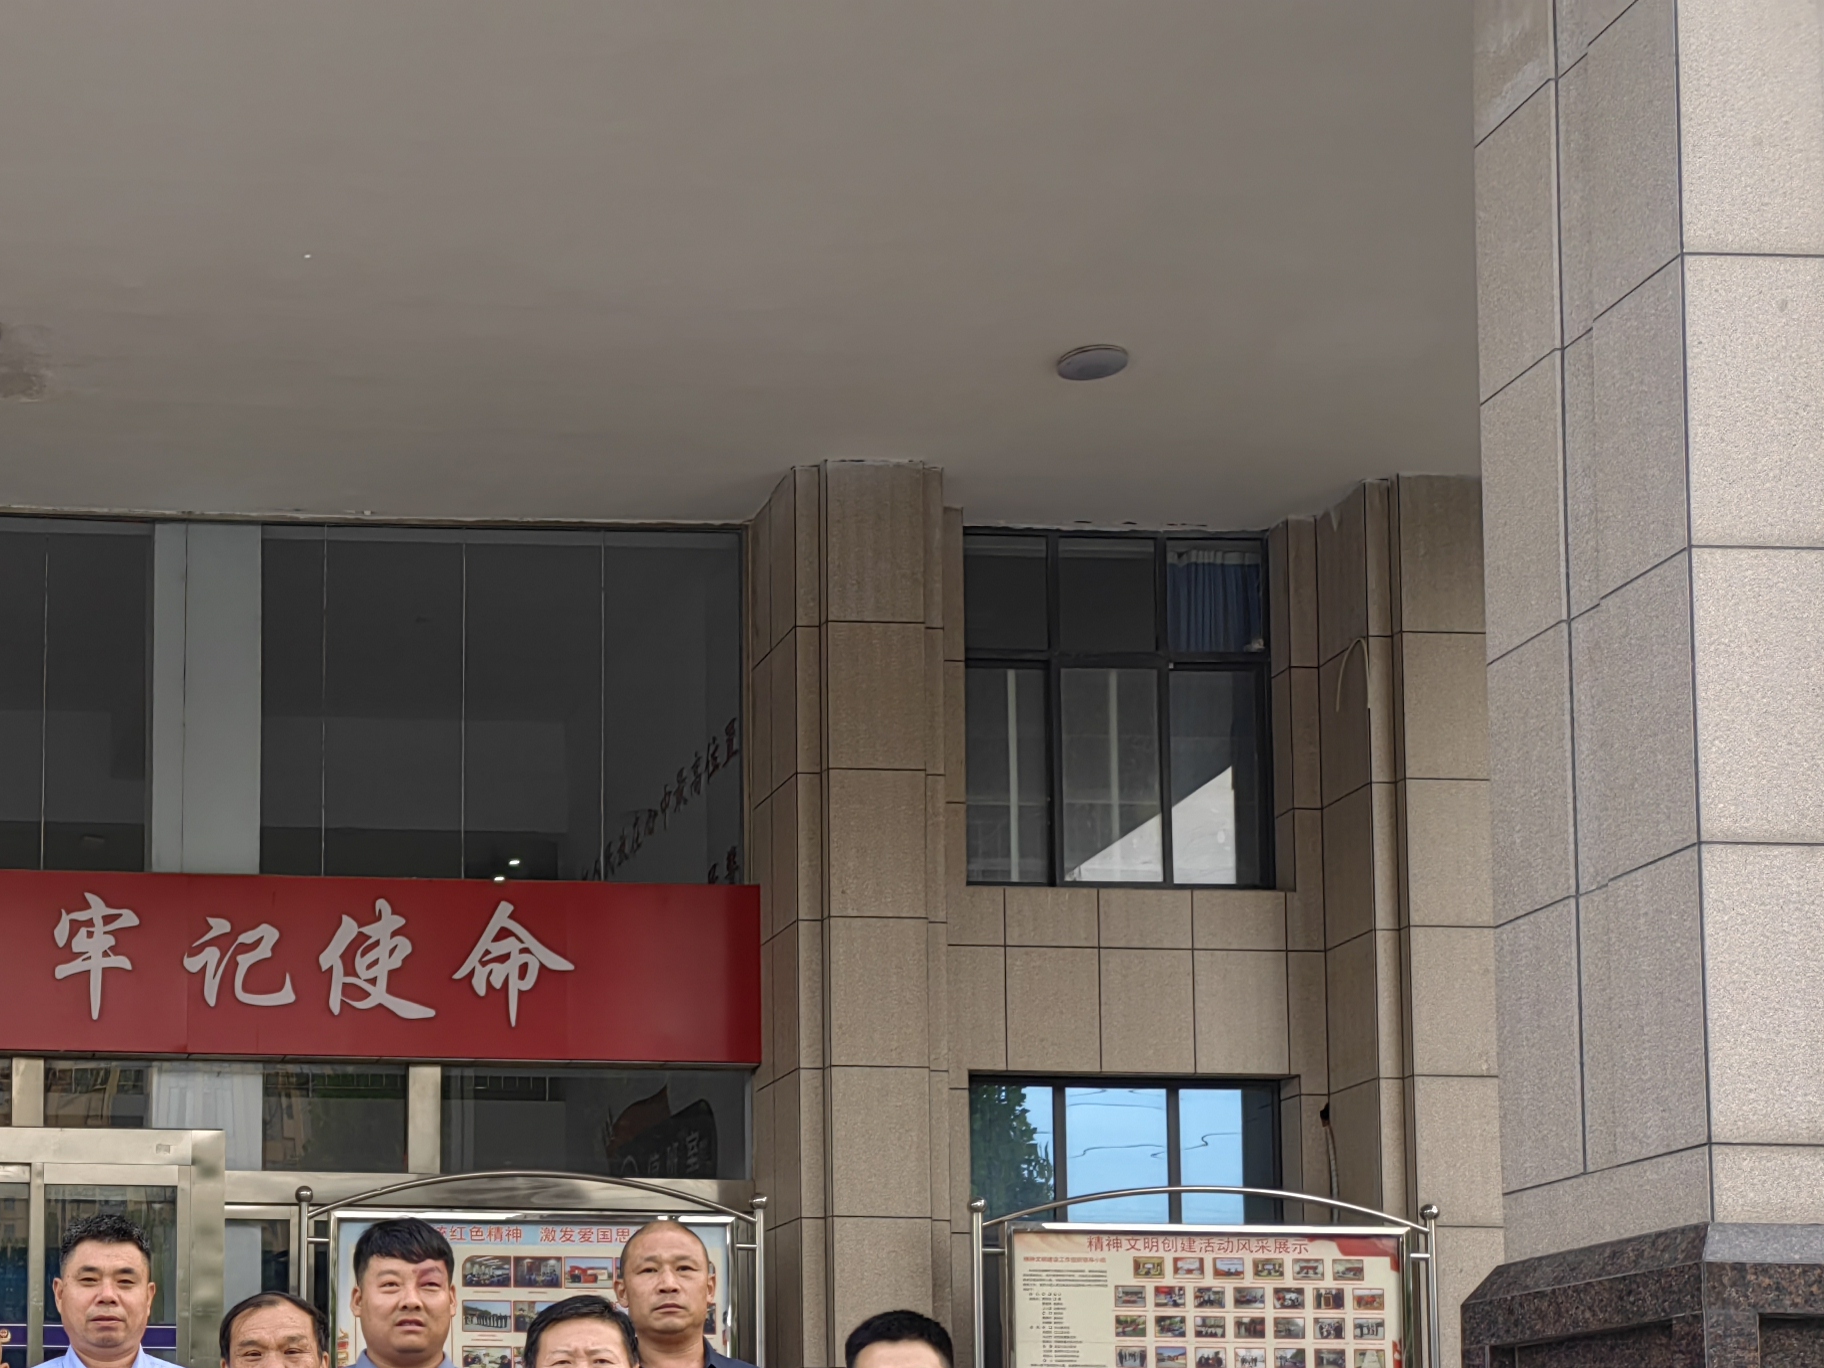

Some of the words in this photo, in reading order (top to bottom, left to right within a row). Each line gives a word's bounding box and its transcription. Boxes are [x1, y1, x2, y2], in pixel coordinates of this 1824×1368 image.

[54, 891, 575, 1028] 牢记使命
[539, 1227, 640, 1244] 激发爱国思
[1086, 1235, 1310, 1254] 精神文明创建活动风采展示
